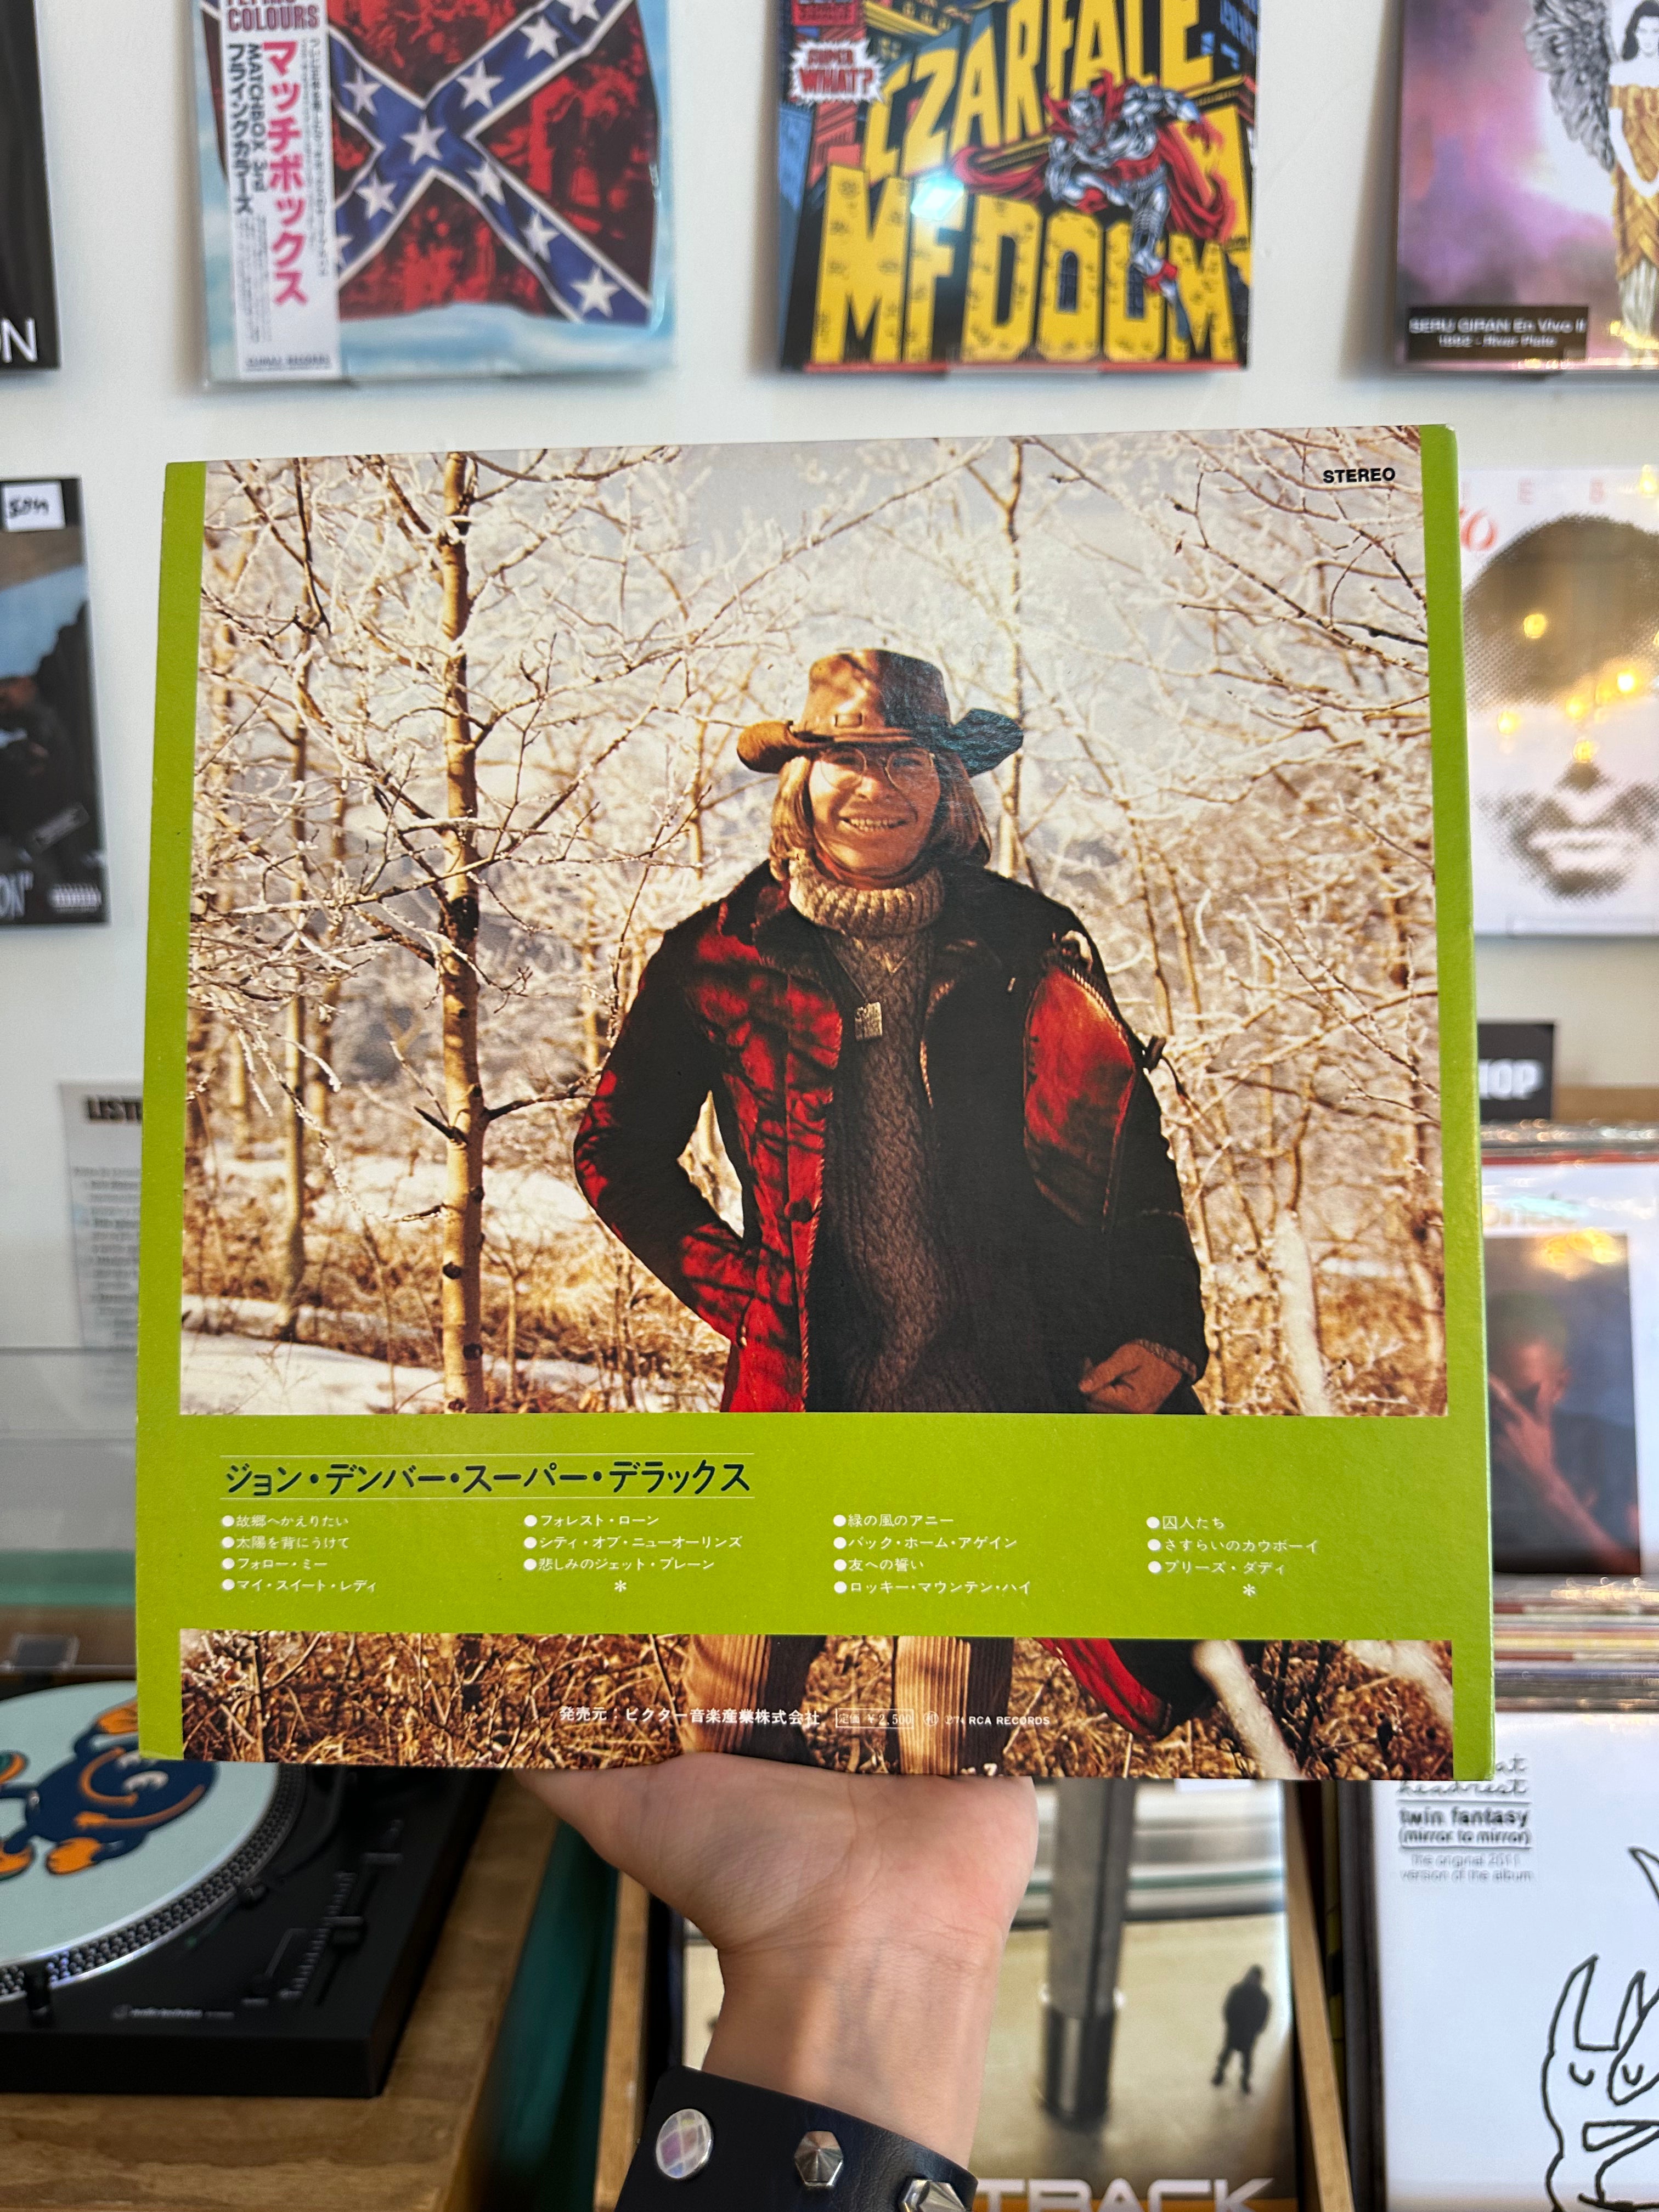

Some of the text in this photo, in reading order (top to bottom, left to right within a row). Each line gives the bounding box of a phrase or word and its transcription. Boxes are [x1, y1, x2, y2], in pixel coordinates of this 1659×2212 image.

[228, 5, 320, 31] COLOURS
[799, 67, 874, 94] WHAT?
[247, 43, 268, 151] MATCHBOX
[263, 41, 307, 305] マッチボックス
[809, 163, 1240, 364] MF DOOM
[1537, 317, 1574, 334] Vivo
[0, 317, 38, 363] N
[1323, 467, 1396, 483] STEREO
[226, 1459, 751, 1496] ジョン・デンバー・スーパー・デラックス
[236, 1514, 349, 1528] 故郷へかえりたい
[540, 1514, 659, 1527] フォレスト・ローン
[848, 1514, 954, 1527] 緑の風のアニー
[1163, 1516, 1225, 1531] 囚人たち
[236, 1535, 349, 1549] 太陽を背にうけて
[1165, 1538, 1317, 1554] さすらいのカウボーイ
[237, 1558, 328, 1570] フォロー・ミー
[848, 1558, 924, 1572] 友への誓い
[236, 1579, 376, 1592] マイ・スイート・レディ
[969, 1716, 992, 1725] RCA
[996, 1716, 1050, 1726] RECORDS
[1400, 1806, 1531, 1828] twin fantasy
[1400, 1827, 1532, 1845] (mirror to mirror)
